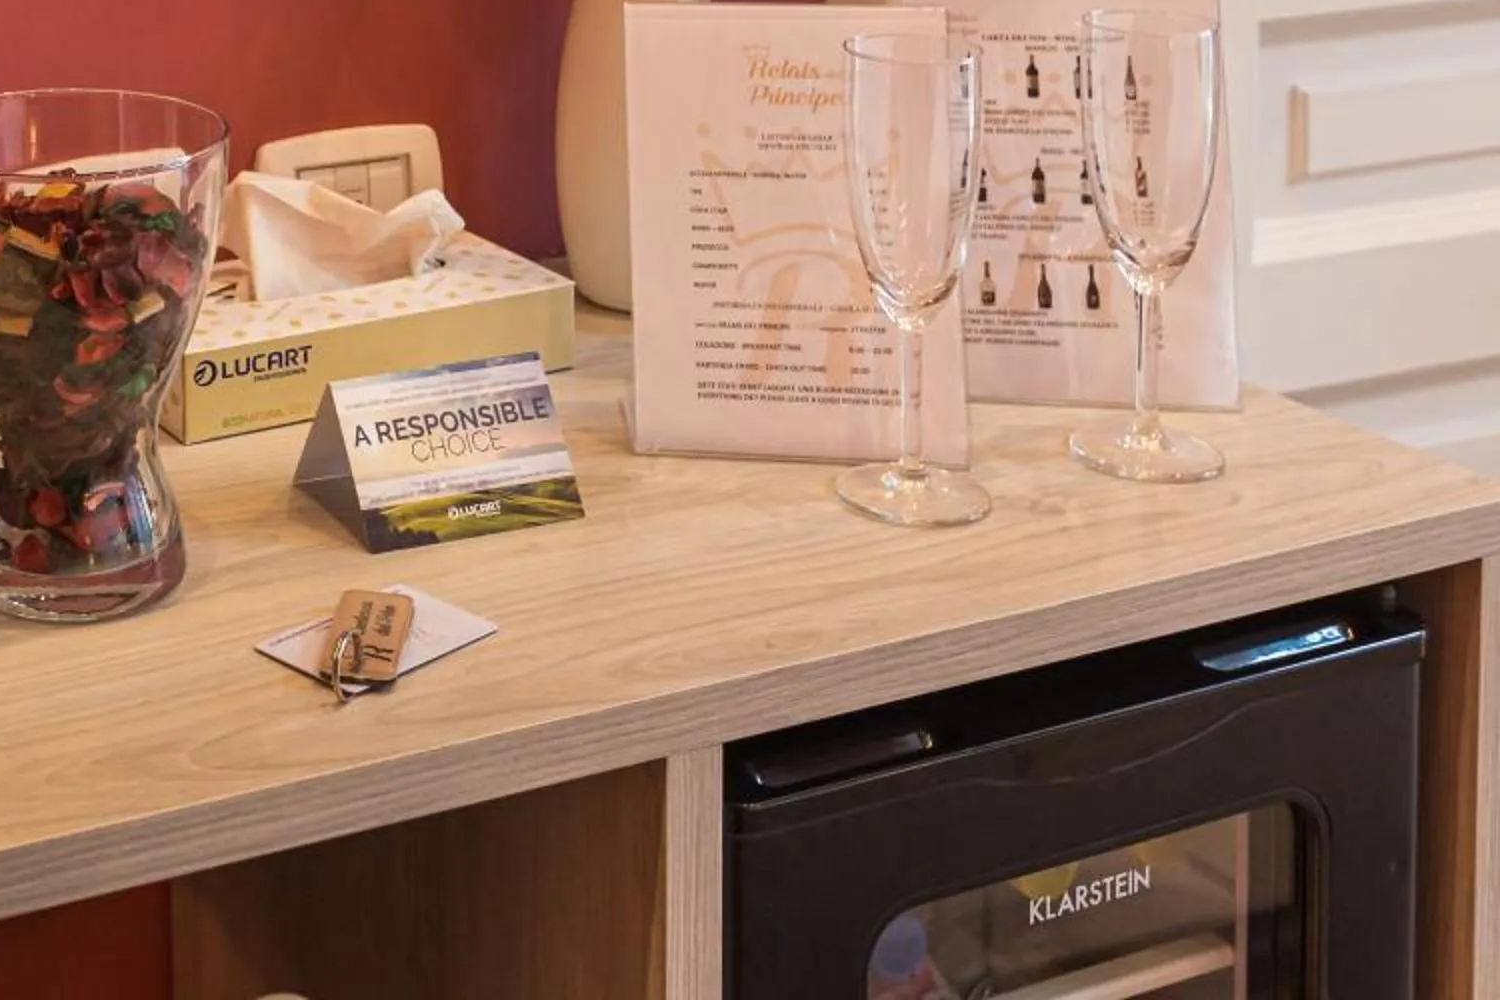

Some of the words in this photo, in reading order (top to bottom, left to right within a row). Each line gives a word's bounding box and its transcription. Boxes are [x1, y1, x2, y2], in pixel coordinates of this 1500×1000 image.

[221, 345, 312, 379] LUCART
[355, 424, 372, 448] A
[375, 397, 550, 445] RESPONSIBLE
[411, 427, 506, 463] CHOICE
[1028, 864, 1151, 926] KLARSTEIN
